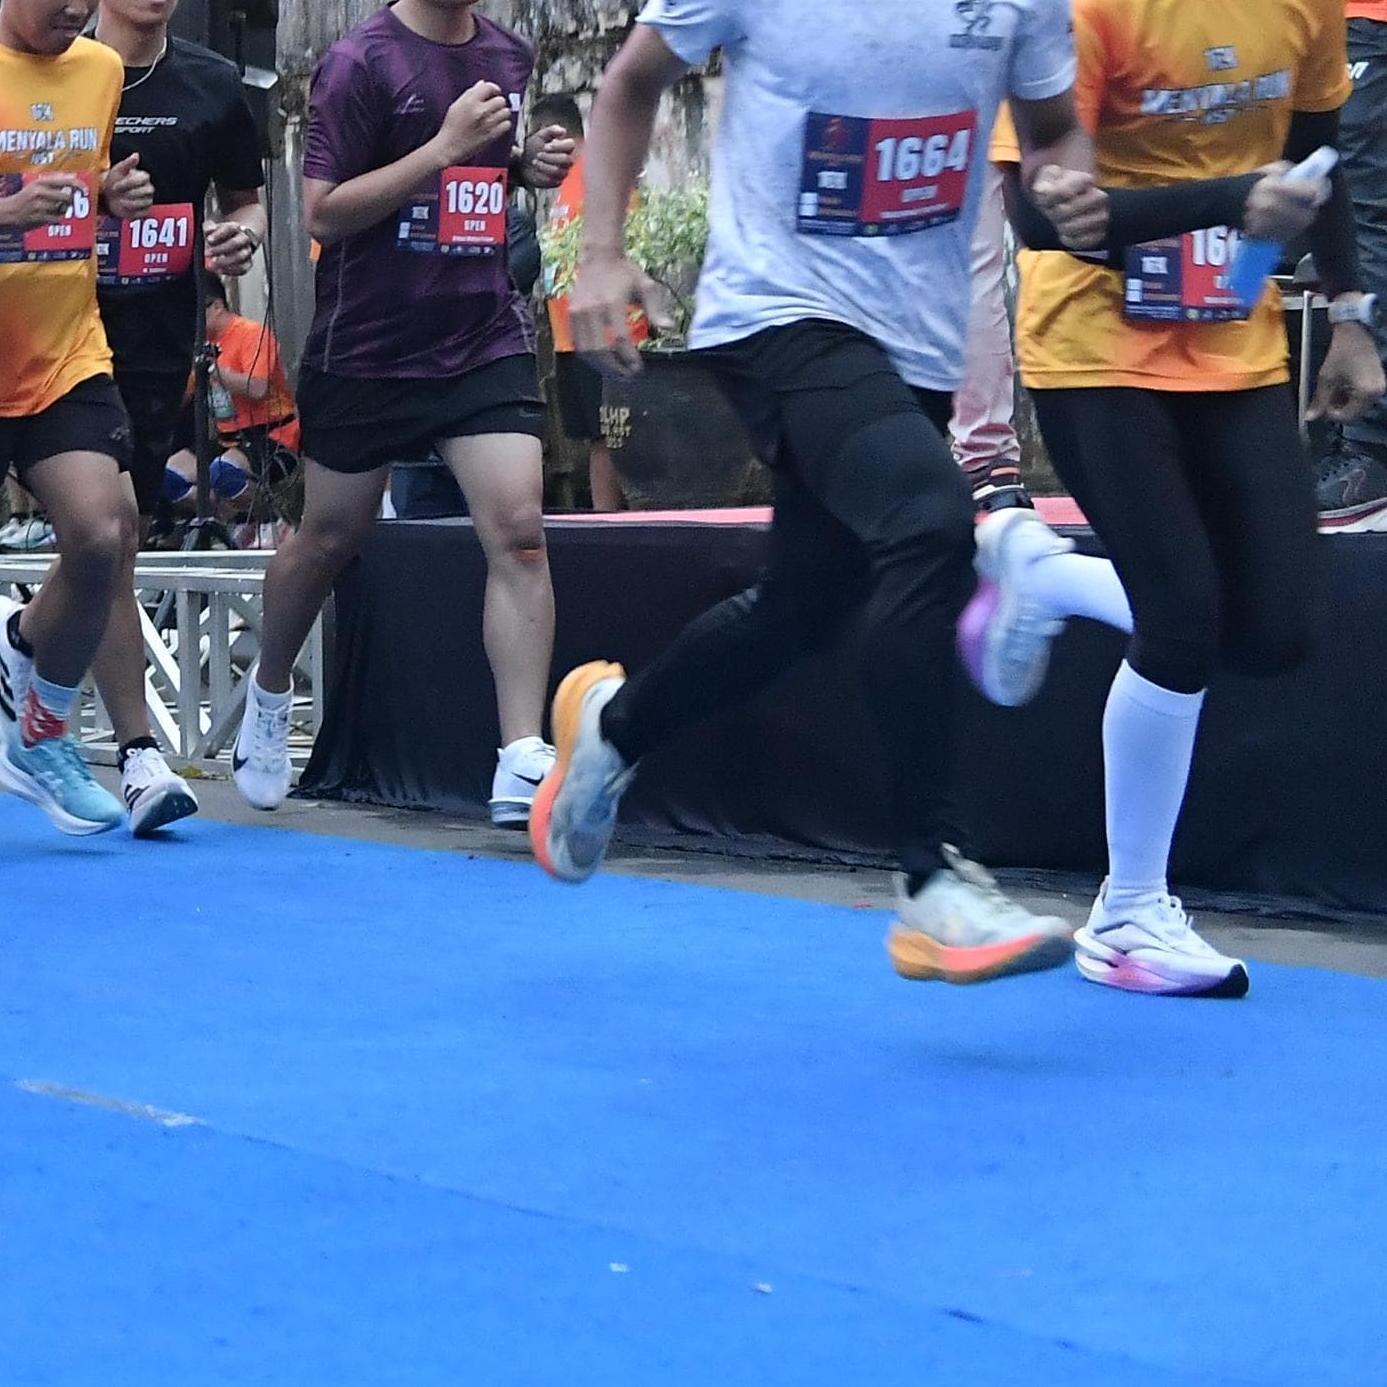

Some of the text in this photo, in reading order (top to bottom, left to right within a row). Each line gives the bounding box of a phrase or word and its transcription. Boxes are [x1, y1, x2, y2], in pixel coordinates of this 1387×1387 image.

[115, 117, 177, 126] ECHERS
[69, 128, 97, 151] RUN
[875, 128, 971, 182] 1664
[446, 180, 504, 215] 1620
[129, 217, 187, 248] 1641
[1191, 225, 1242, 266] 16
[144, 253, 168, 263] OPEN
